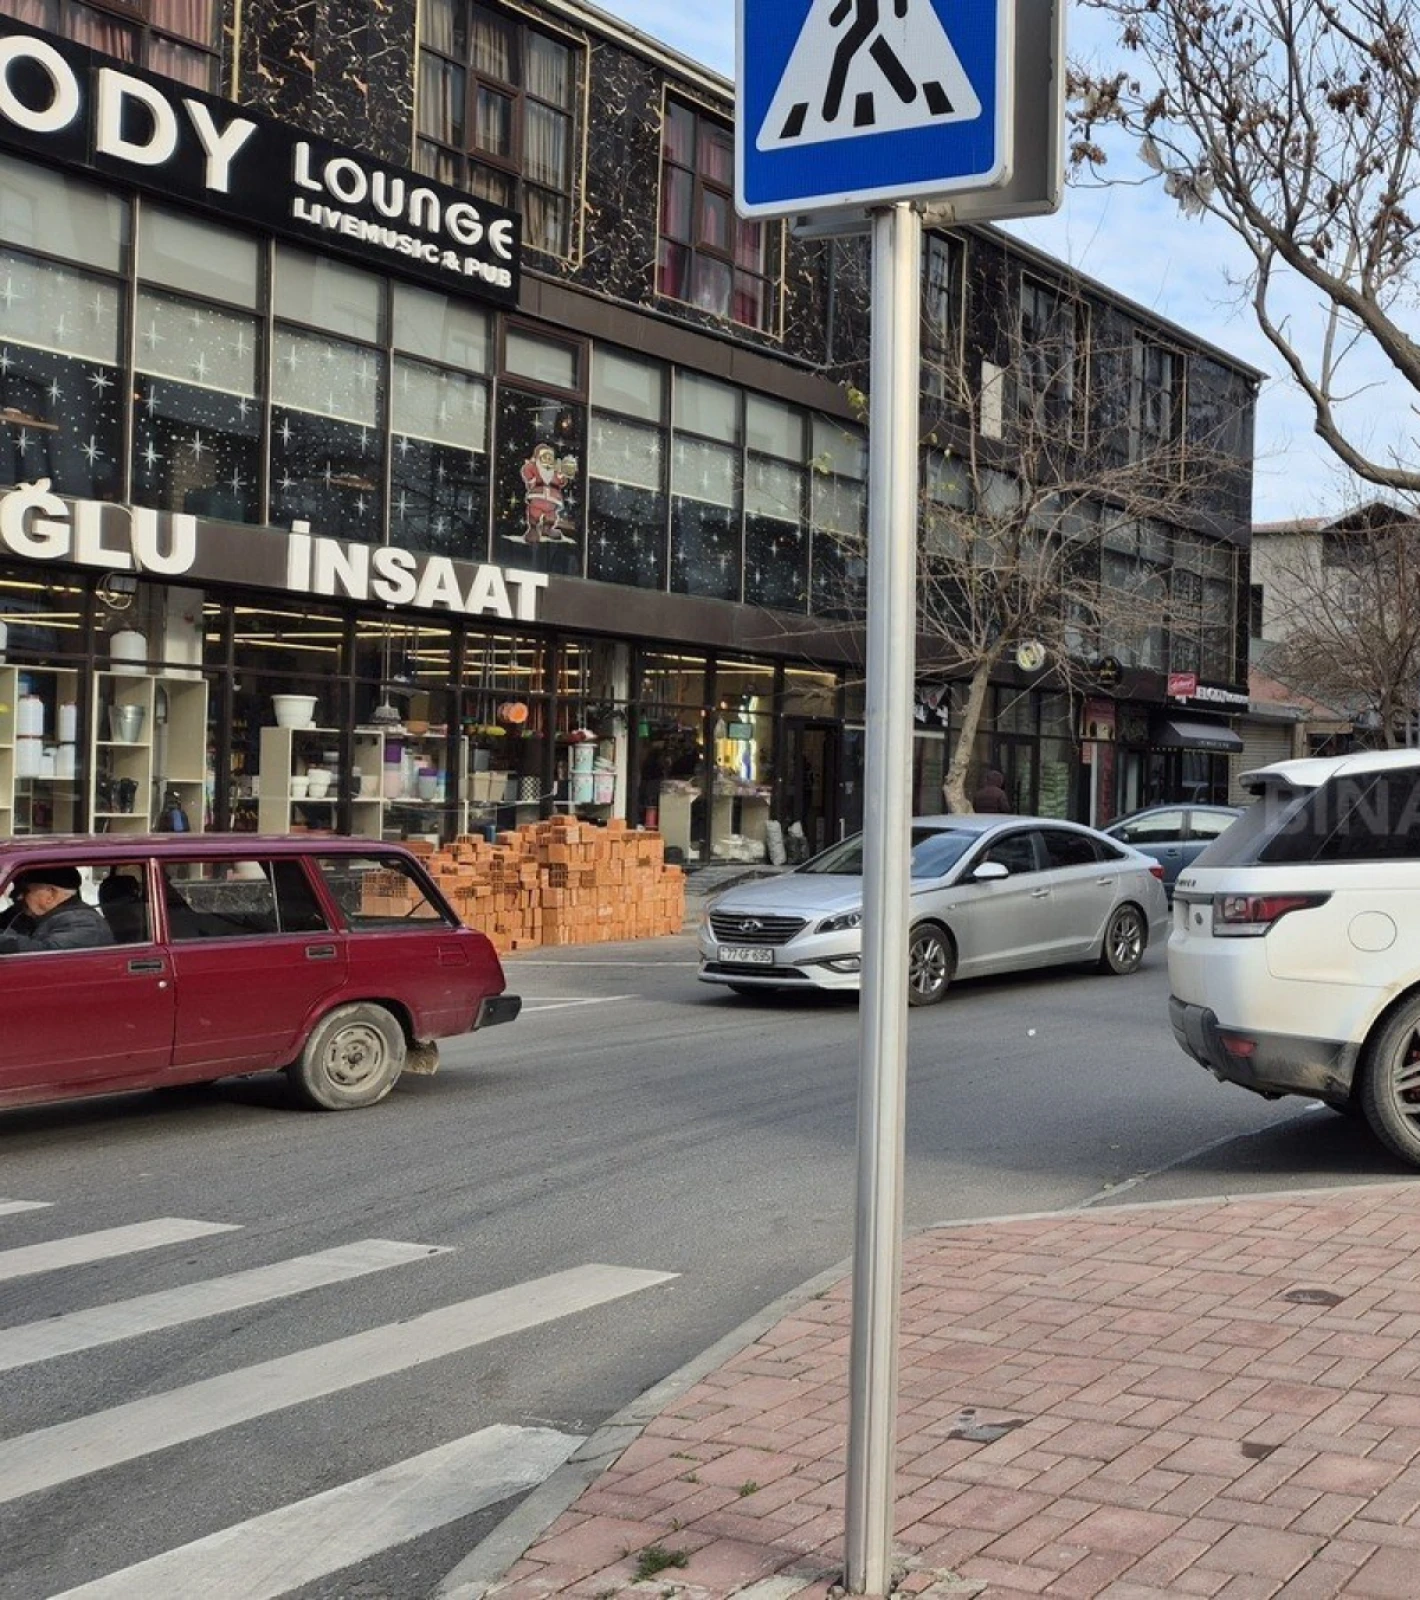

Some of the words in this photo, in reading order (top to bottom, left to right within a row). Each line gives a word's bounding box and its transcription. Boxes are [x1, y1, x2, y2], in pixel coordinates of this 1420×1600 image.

[0, 35, 258, 193] ODY
[293, 197, 440, 264] LIVEMUSIC
[441, 251, 461, 272] &
[464, 258, 512, 288] PUB
